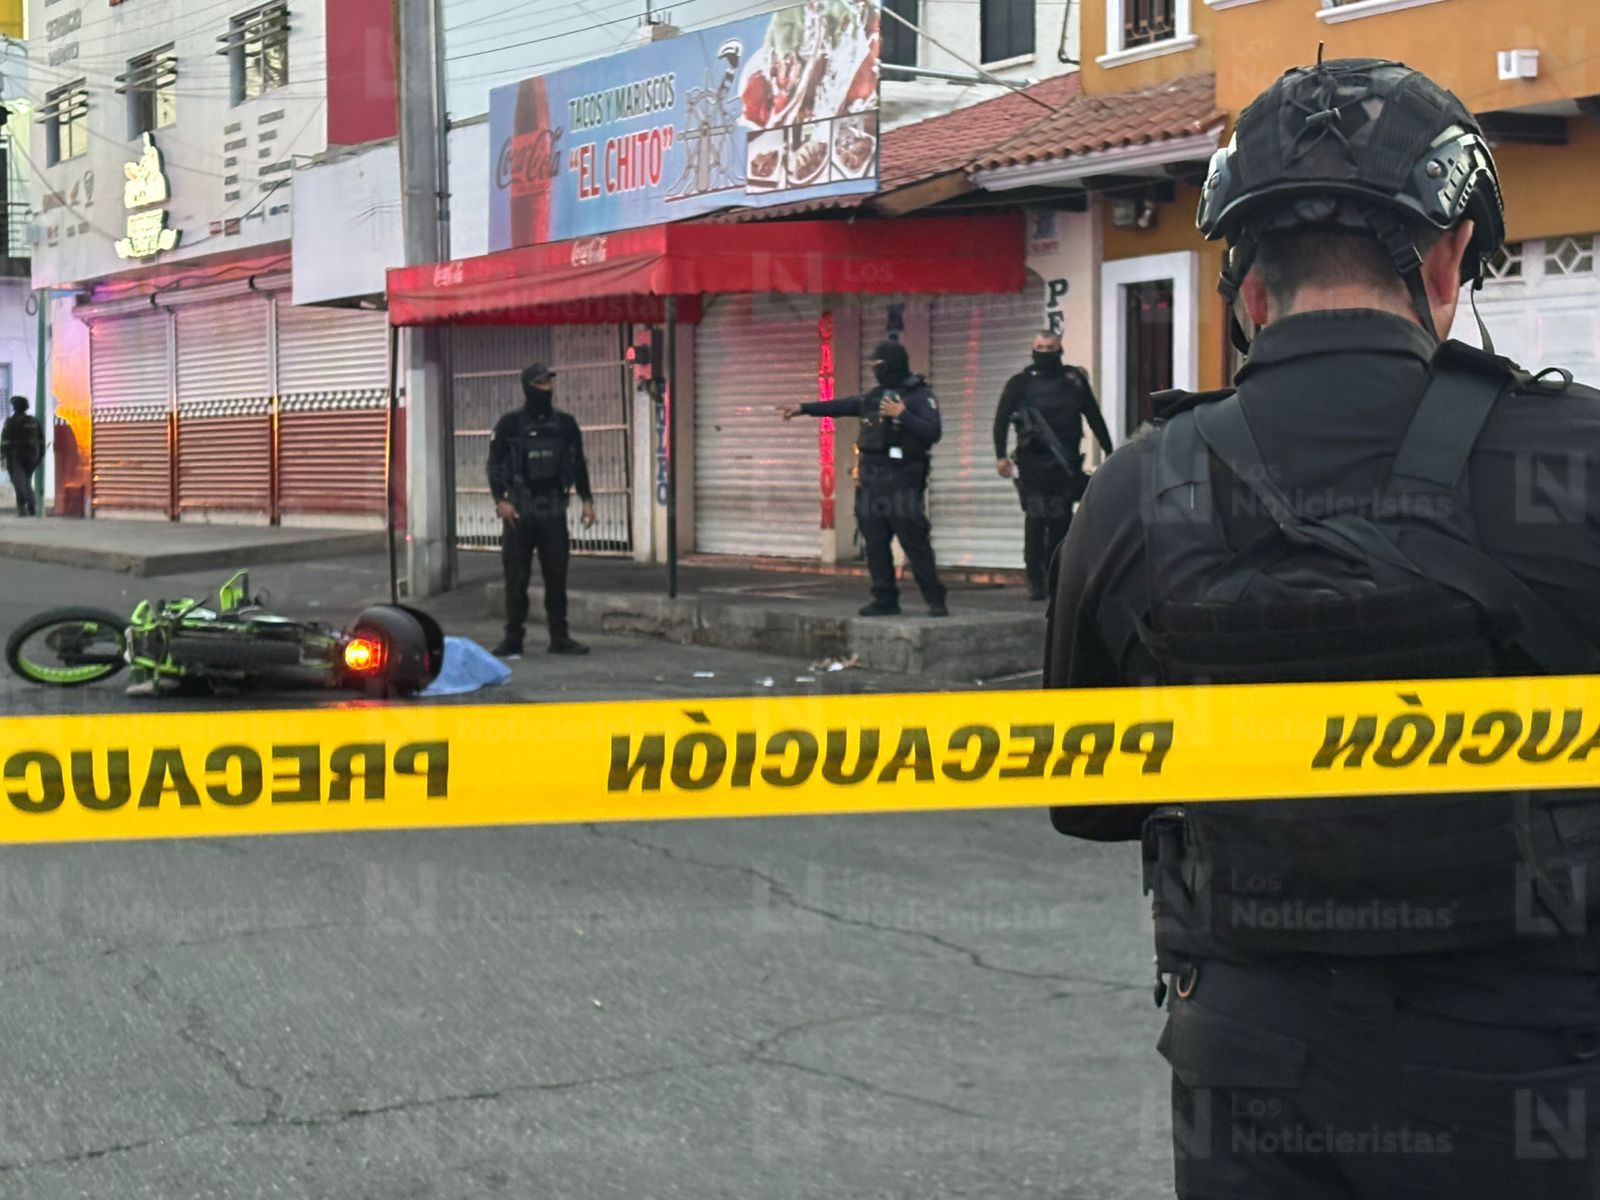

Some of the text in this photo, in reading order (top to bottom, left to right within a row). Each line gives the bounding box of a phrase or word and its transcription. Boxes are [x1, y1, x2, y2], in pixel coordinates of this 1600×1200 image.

[570, 73, 676, 132] TACOS Y MARISCOS
